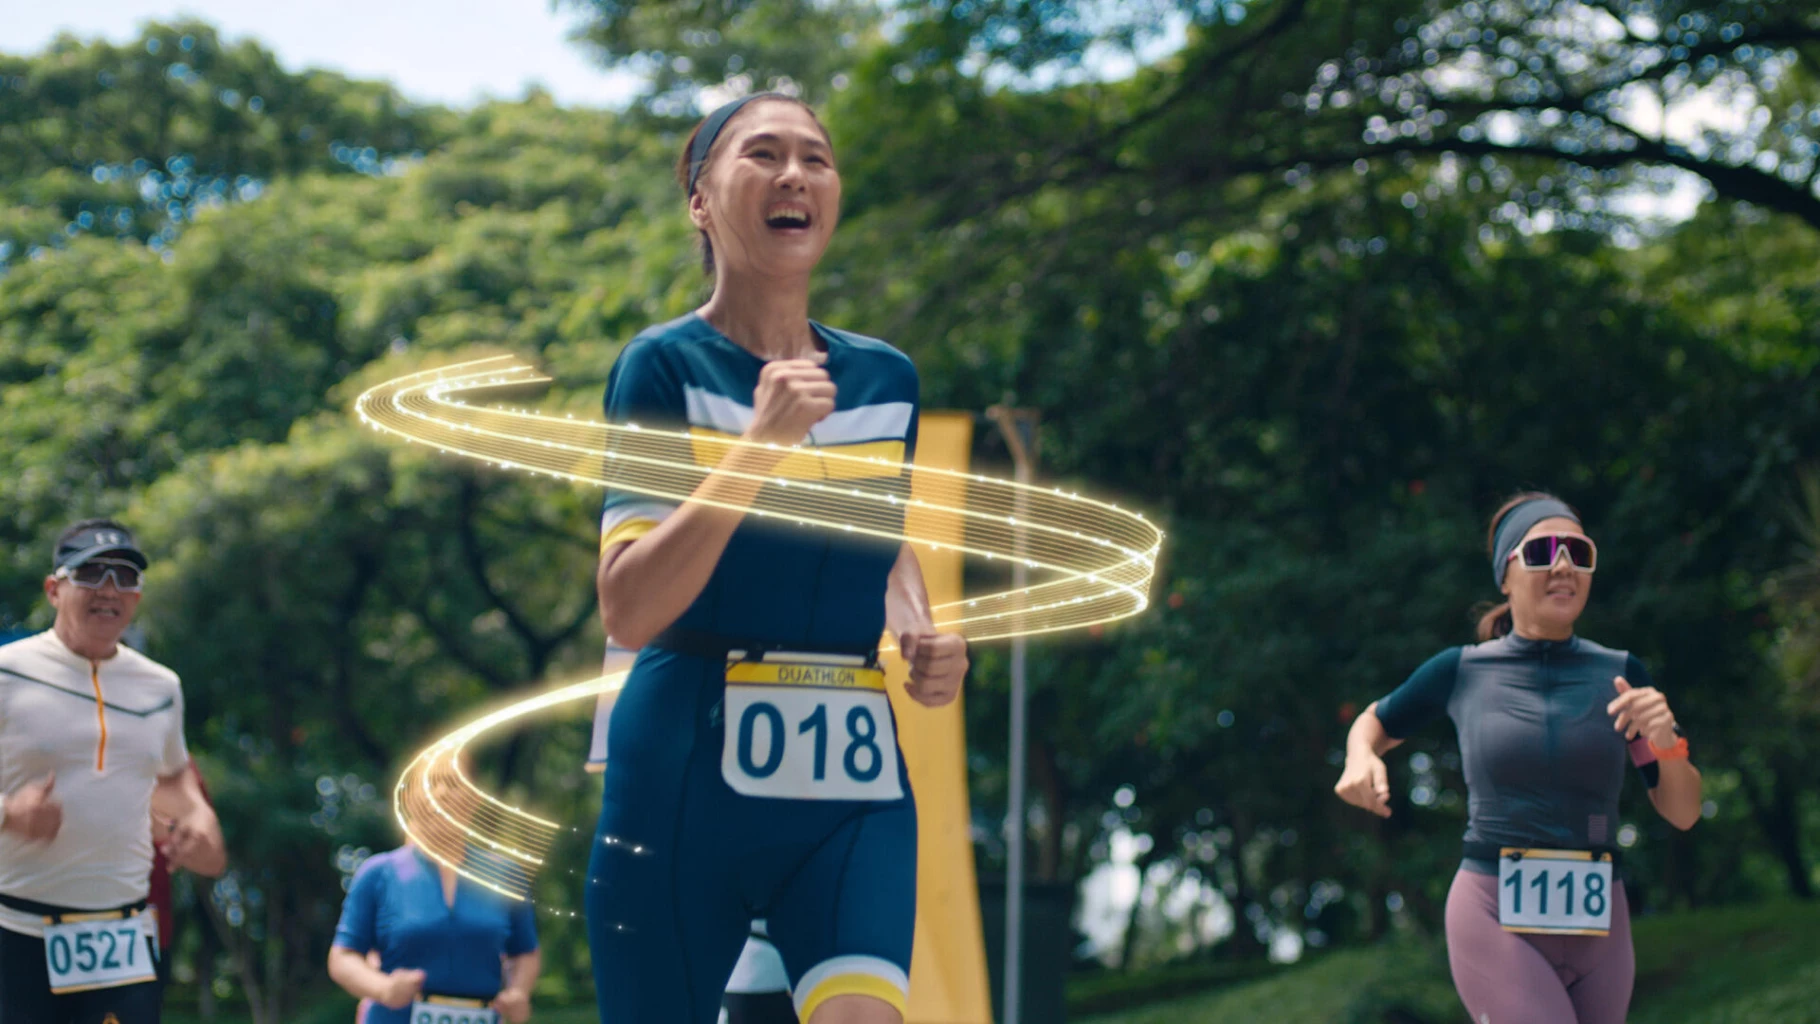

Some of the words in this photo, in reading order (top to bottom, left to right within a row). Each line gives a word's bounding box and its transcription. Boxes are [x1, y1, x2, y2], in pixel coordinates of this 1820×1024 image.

[777, 667, 855, 685] DUATHLON
[737, 701, 883, 783] 018
[1504, 869, 1606, 917] 1118
[50, 929, 136, 975] 0527
